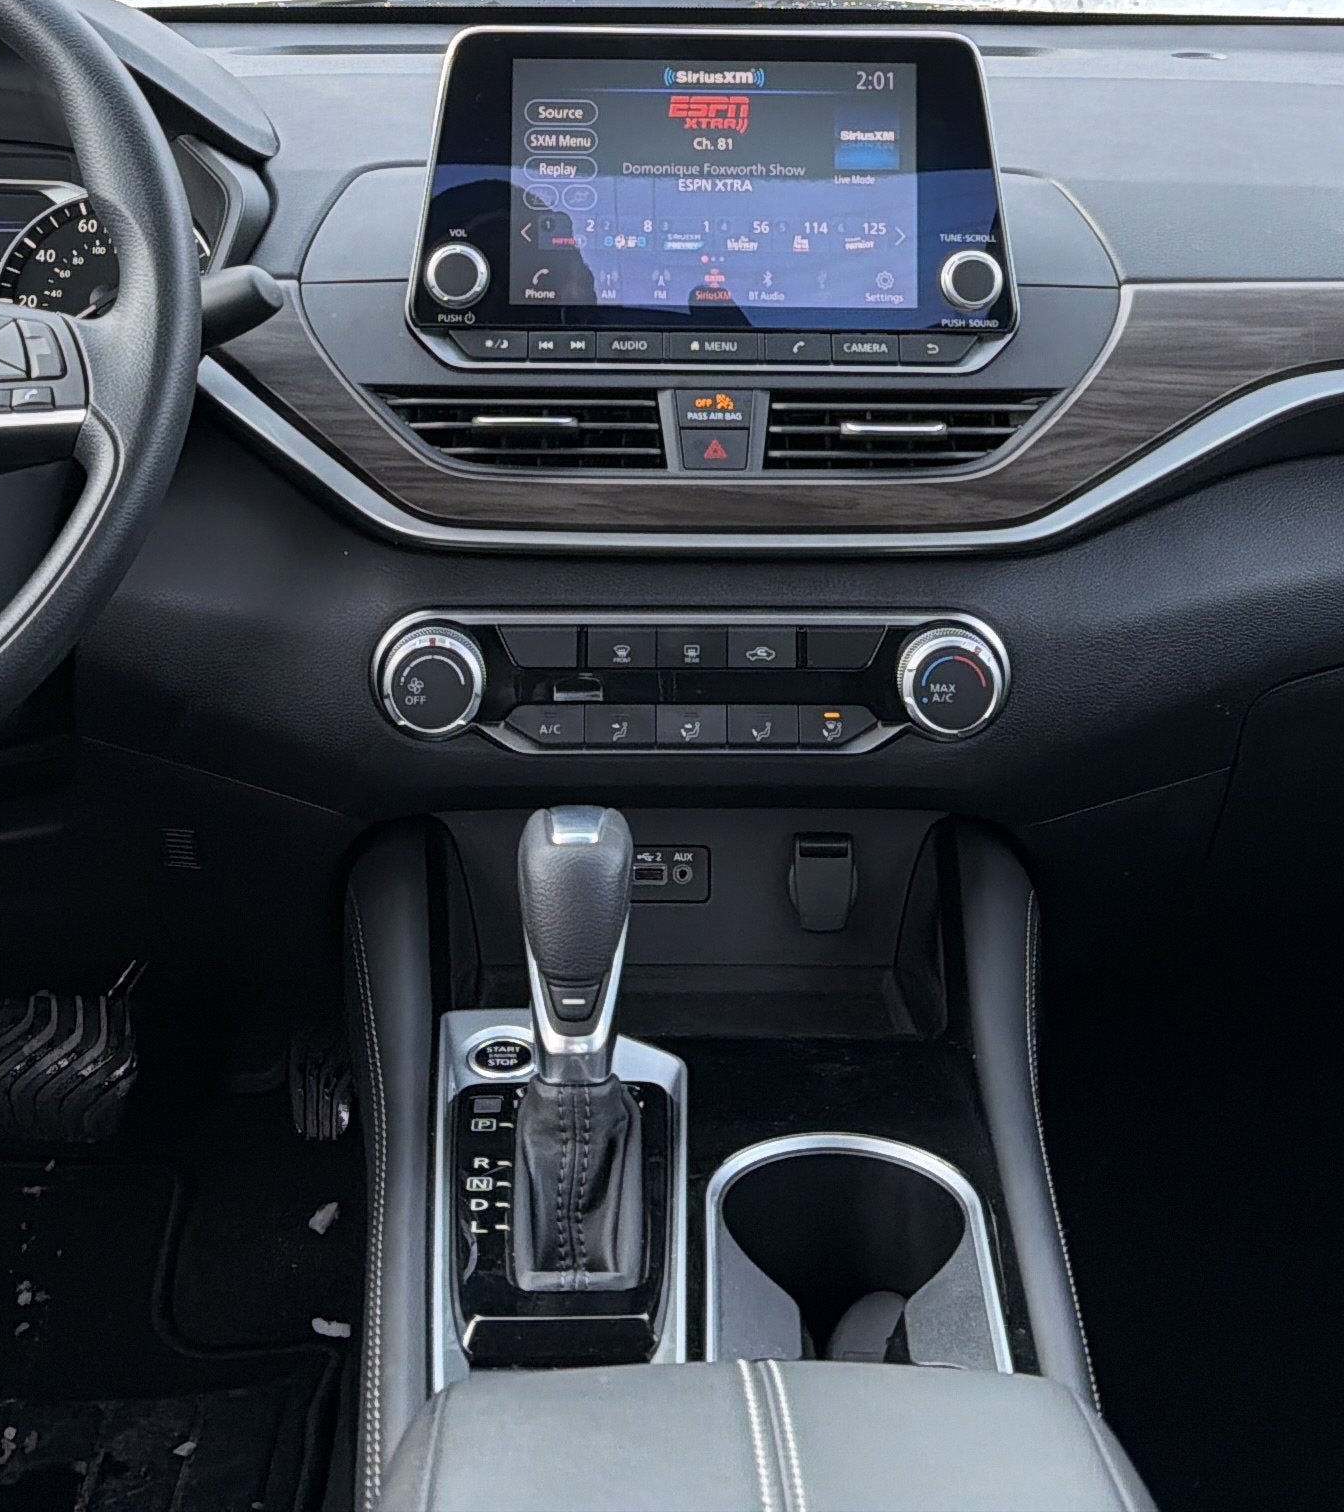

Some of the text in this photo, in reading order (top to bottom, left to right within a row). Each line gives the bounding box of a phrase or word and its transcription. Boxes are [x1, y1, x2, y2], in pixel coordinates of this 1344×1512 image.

[855, 70, 895, 91] 2:01
[538, 105, 584, 120] Source
[668, 95, 752, 119] ESPN
[683, 118, 739, 131] XTRA
[530, 134, 592, 148] SXM Menu
[693, 137, 734, 151] Ch. 81
[539, 162, 578, 178] Replay
[622, 162, 806, 178] Domonique Foxworth Show
[834, 174, 875, 185] Live Mode
[678, 179, 754, 192] ESPN XTRA
[77, 219, 98, 233] 60
[585, 219, 595, 233] 2
[643, 219, 654, 233] 8
[703, 219, 711, 233] 1
[753, 221, 770, 234] 56
[804, 221, 829, 235] 114
[862, 222, 887, 236] 125
[449, 228, 468, 238] VOL
[35, 249, 56, 263] 40
[91, 246, 107, 255] 100
[72, 256, 85, 266] 80
[59, 270, 71, 278] 60
[50, 289, 63, 298] 40
[525, 289, 556, 299] Phone
[601, 289, 617, 299] AM
[654, 290, 667, 299] FM
[748, 291, 785, 301] BT Audio
[865, 292, 905, 304] Settings
[18, 294, 38, 308] 20
[437, 314, 463, 323] PUSH
[941, 318, 1000, 328] PUSH SOUND
[611, 341, 648, 351] AUDIO
[704, 341, 738, 352] MENU
[842, 342, 888, 353] CAMERA
[695, 398, 713, 408] OFF
[687, 412, 743, 421] PASS AIR BAG
[930, 683, 956, 693] MAX
[404, 695, 427, 706] OFF
[932, 693, 954, 703] A/C
[539, 724, 561, 735] A/C
[673, 852, 694, 862] AUX
[487, 1058, 518, 1067] STOP
[473, 1157, 490, 1169] R
[470, 1198, 489, 1211] D
[470, 1220, 489, 1234] L
